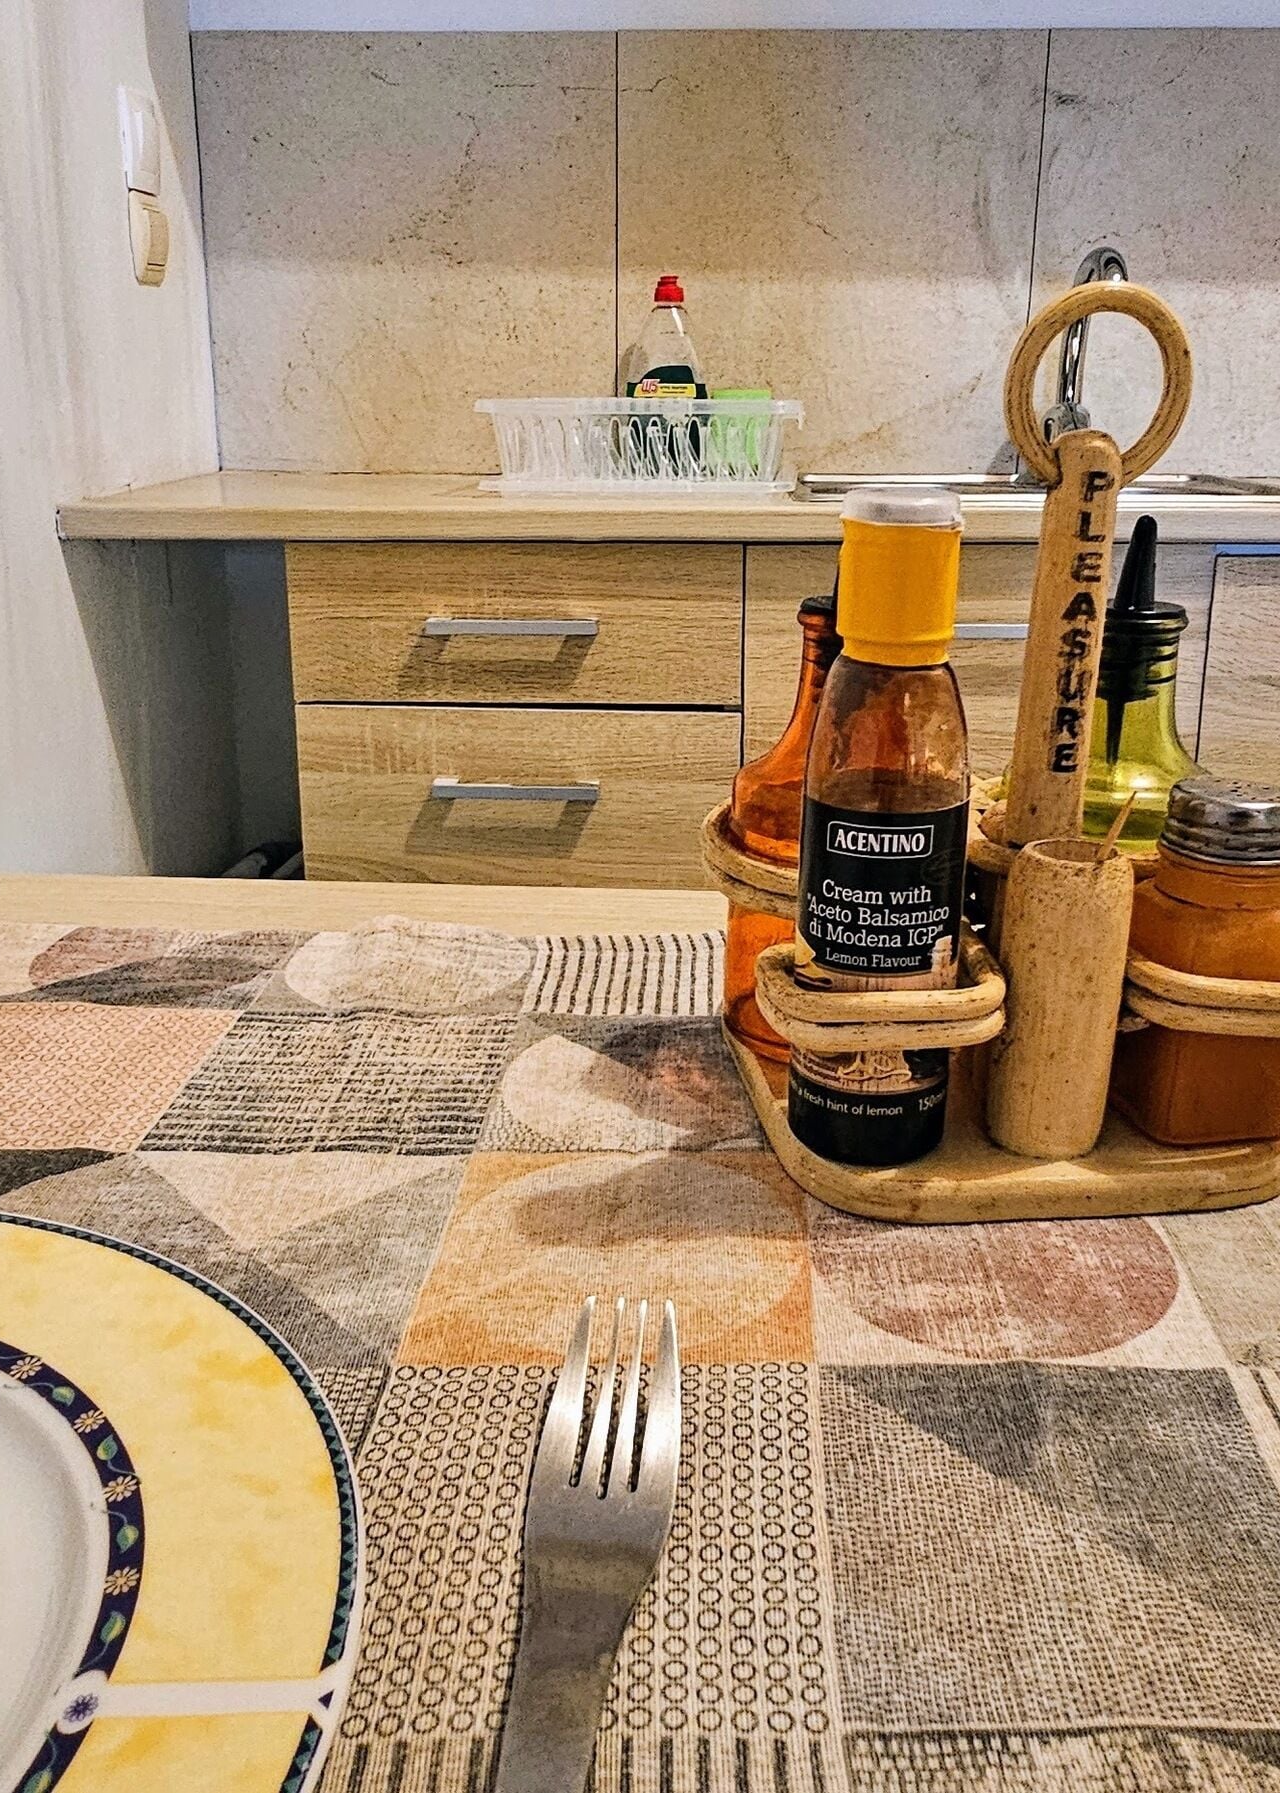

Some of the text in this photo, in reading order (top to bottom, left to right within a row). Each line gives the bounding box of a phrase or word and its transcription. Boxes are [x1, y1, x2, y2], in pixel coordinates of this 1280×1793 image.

[1050, 470, 1115, 773] PLEASURE
[834, 829, 925, 853] ACENTINO
[822, 879, 932, 905] Cream with
[858, 906, 950, 926] Balsamico
[809, 920, 822, 937] di
[826, 923, 902, 948] Modena
[825, 947, 922, 967] Lemon Flavour
[803, 1087, 824, 1107] fresh
[826, 1098, 848, 1113] hint
[851, 1104, 864, 1115] of
[866, 1104, 903, 1116] lemon
